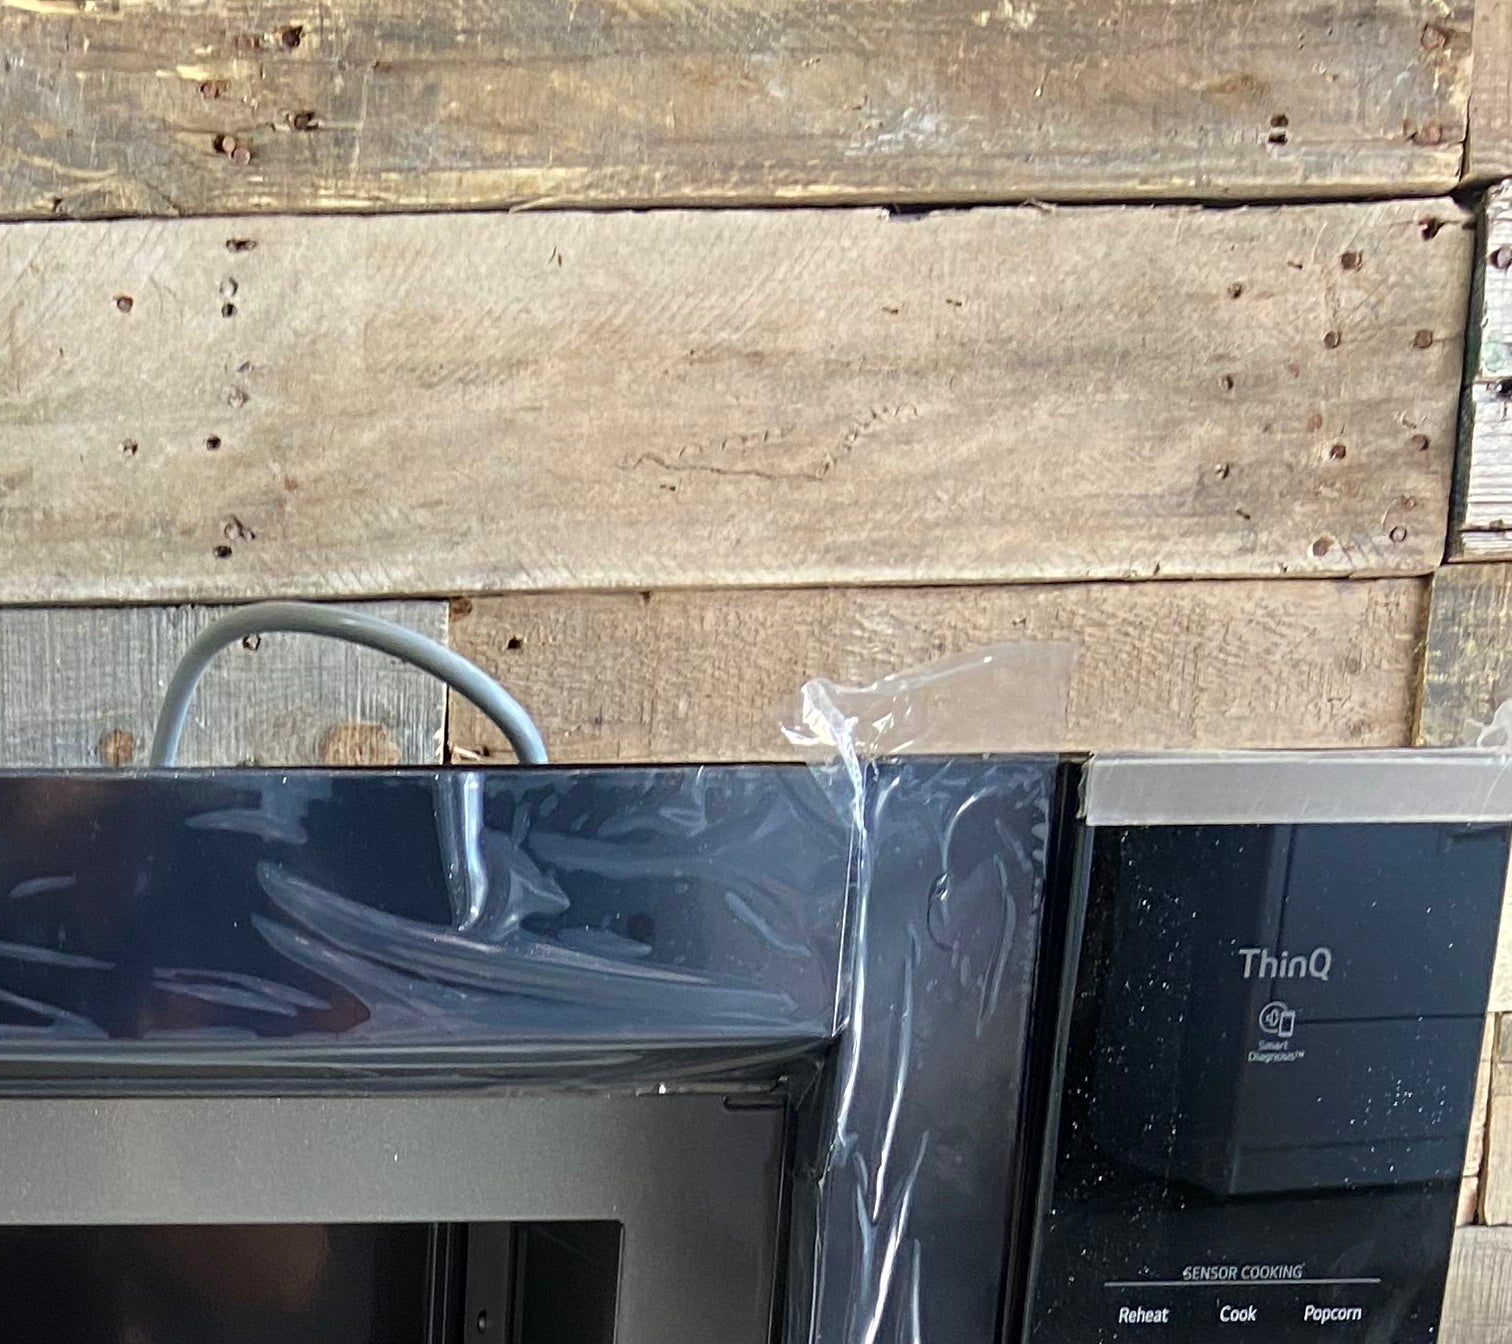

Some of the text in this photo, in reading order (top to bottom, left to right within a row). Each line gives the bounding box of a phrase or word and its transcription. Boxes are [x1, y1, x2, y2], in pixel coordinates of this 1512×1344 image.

[1239, 947, 1331, 981] ThinQ
[1183, 1265, 1303, 1281] SENSOR COOKING
[1118, 1305, 1362, 1324] Reheat Cook Popcorn
